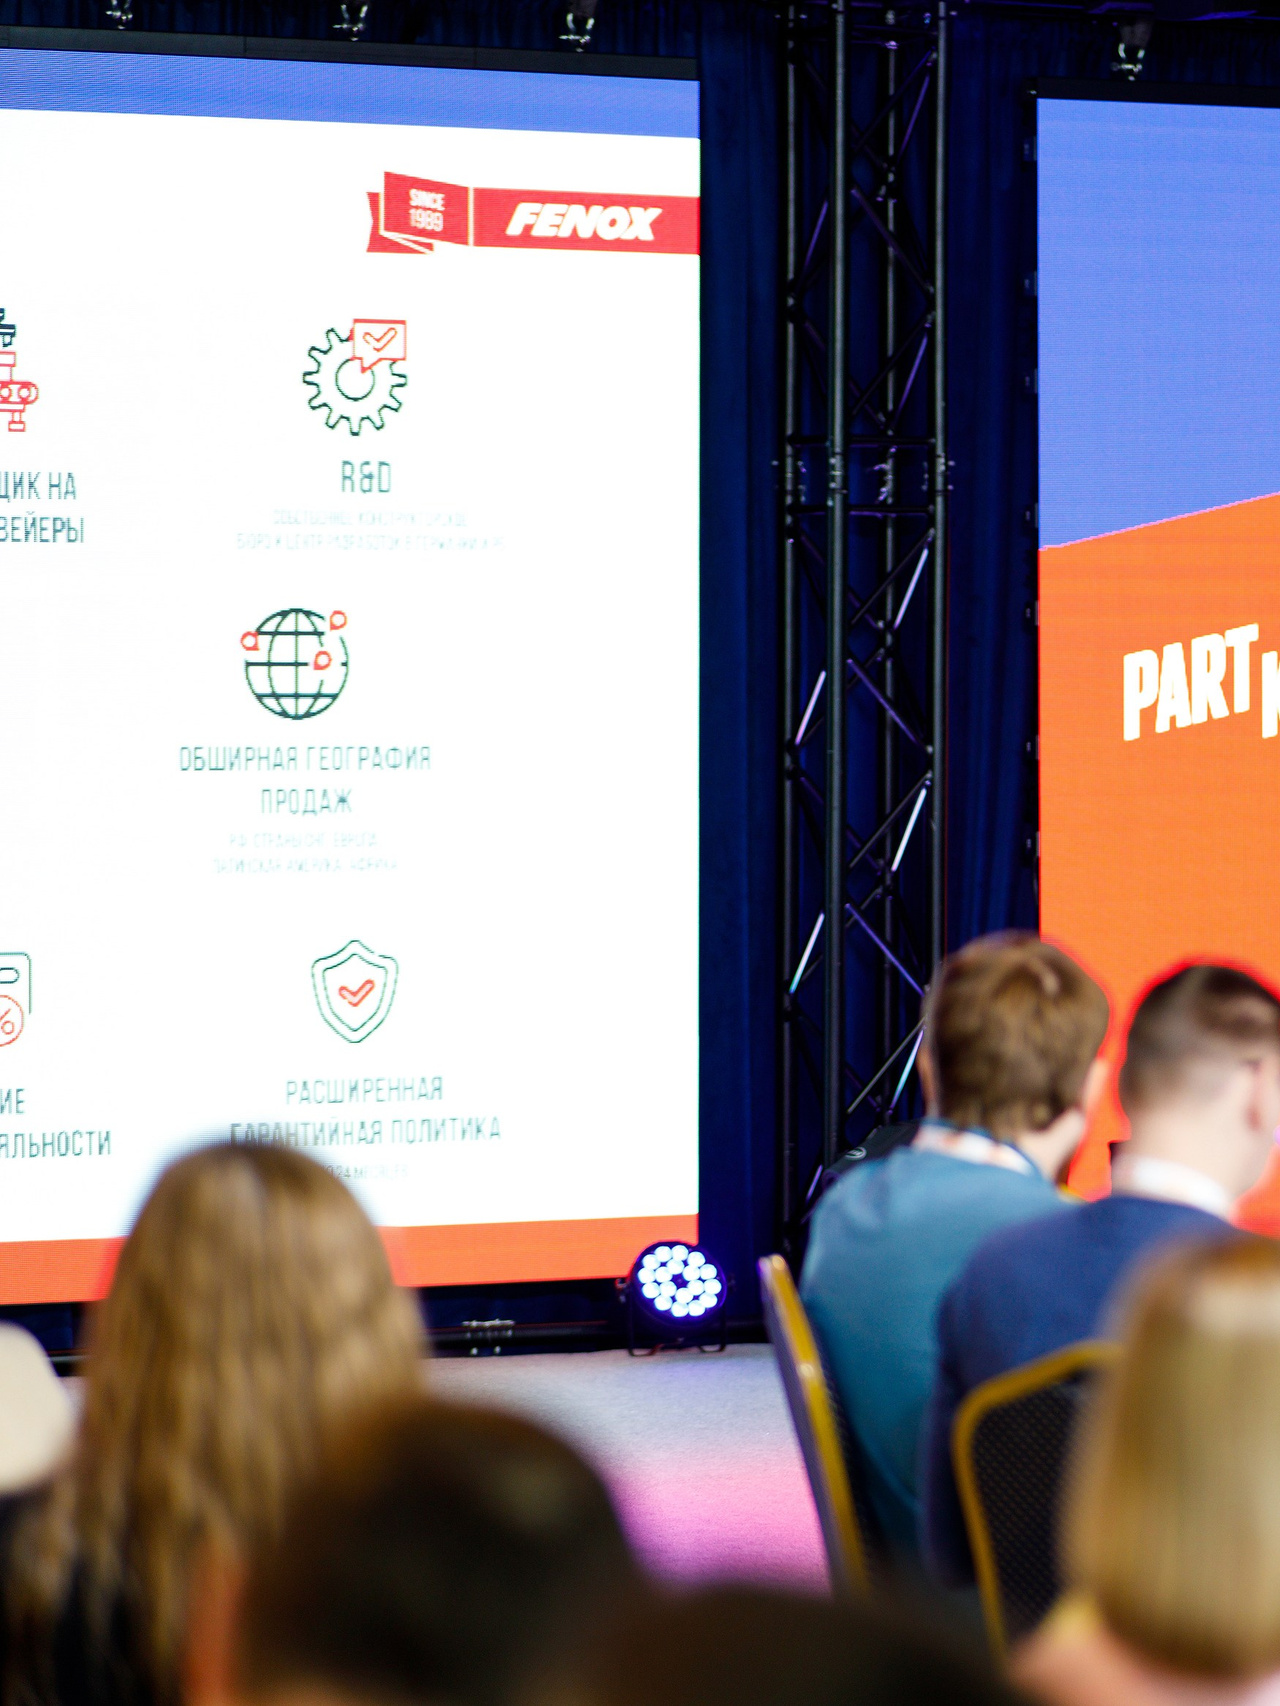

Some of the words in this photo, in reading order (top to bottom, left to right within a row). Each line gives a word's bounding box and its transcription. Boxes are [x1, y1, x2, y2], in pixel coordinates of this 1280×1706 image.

[409, 189, 446, 211] SINCE
[409, 207, 444, 231] 1989
[505, 202, 663, 241] FENOX
[49, 471, 77, 500] НА
[341, 460, 391, 493] R&D
[0, 511, 84, 543] ВЕЙЕРЫ
[1123, 623, 1259, 741] PART
[180, 746, 298, 771] ОБШИРНАЯ
[306, 746, 431, 771] ГЕОГРАФИЯ
[261, 788, 352, 816] ПРОДАЖ
[286, 1076, 444, 1105] РАСШИРЕННАЯ
[229, 1117, 383, 1147] ГАРАНТИЙНАЯ
[391, 1116, 501, 1144] ПОЛИТИКА
